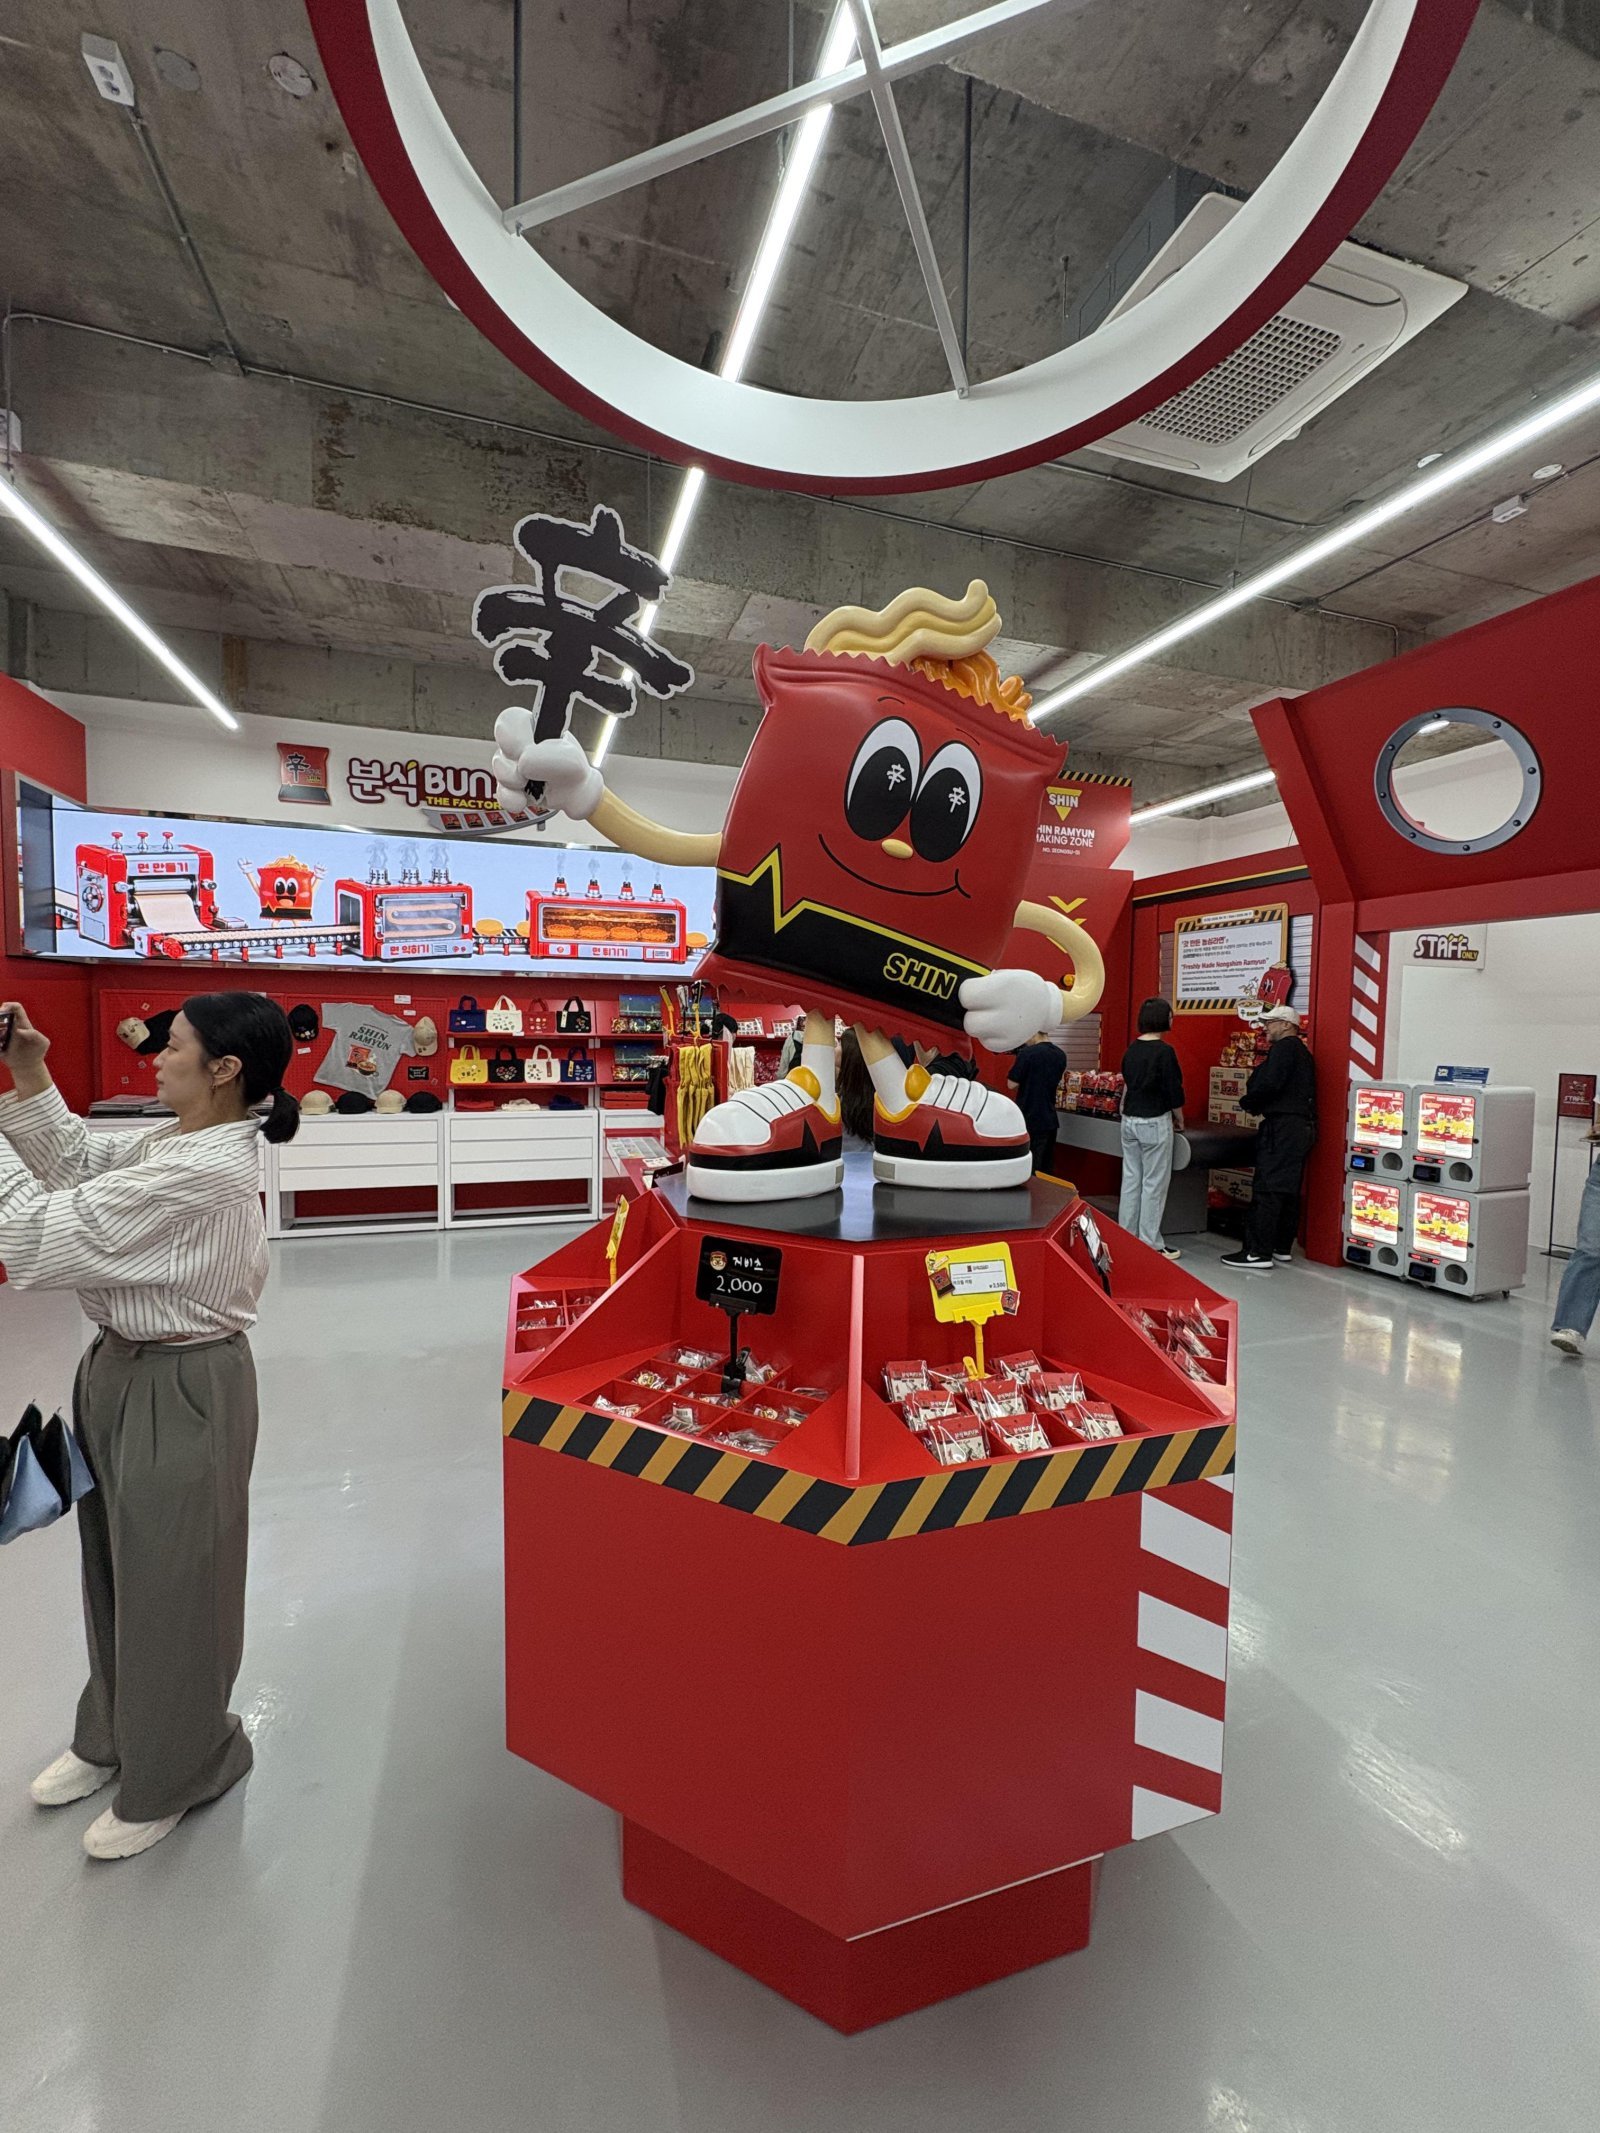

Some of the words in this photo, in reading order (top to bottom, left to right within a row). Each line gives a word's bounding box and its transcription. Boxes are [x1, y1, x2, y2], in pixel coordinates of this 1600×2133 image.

[473, 505, 693, 744] 辛
[347, 758, 418, 806] 분식
[423, 764, 500, 800] BUN
[426, 796, 448, 807] THE
[453, 798, 502, 811] FACTOR
[1048, 793, 1079, 808] SHIN
[1037, 824, 1053, 835] HIN
[1054, 826, 1095, 838] RAMYUN
[1069, 837, 1094, 848] ZONE
[137, 863, 150, 873] 면
[390, 946, 400, 956] 면
[401, 944, 430, 955] 익히기
[592, 947, 601, 956] 면
[1414, 933, 1469, 959] STAFF
[1461, 951, 1478, 960] ONLY
[883, 952, 958, 1000] SHIN
[348, 1031, 392, 1051] RAMYUN
[357, 1026, 389, 1041] SHIN
[716, 1275, 763, 1294] 2,000
